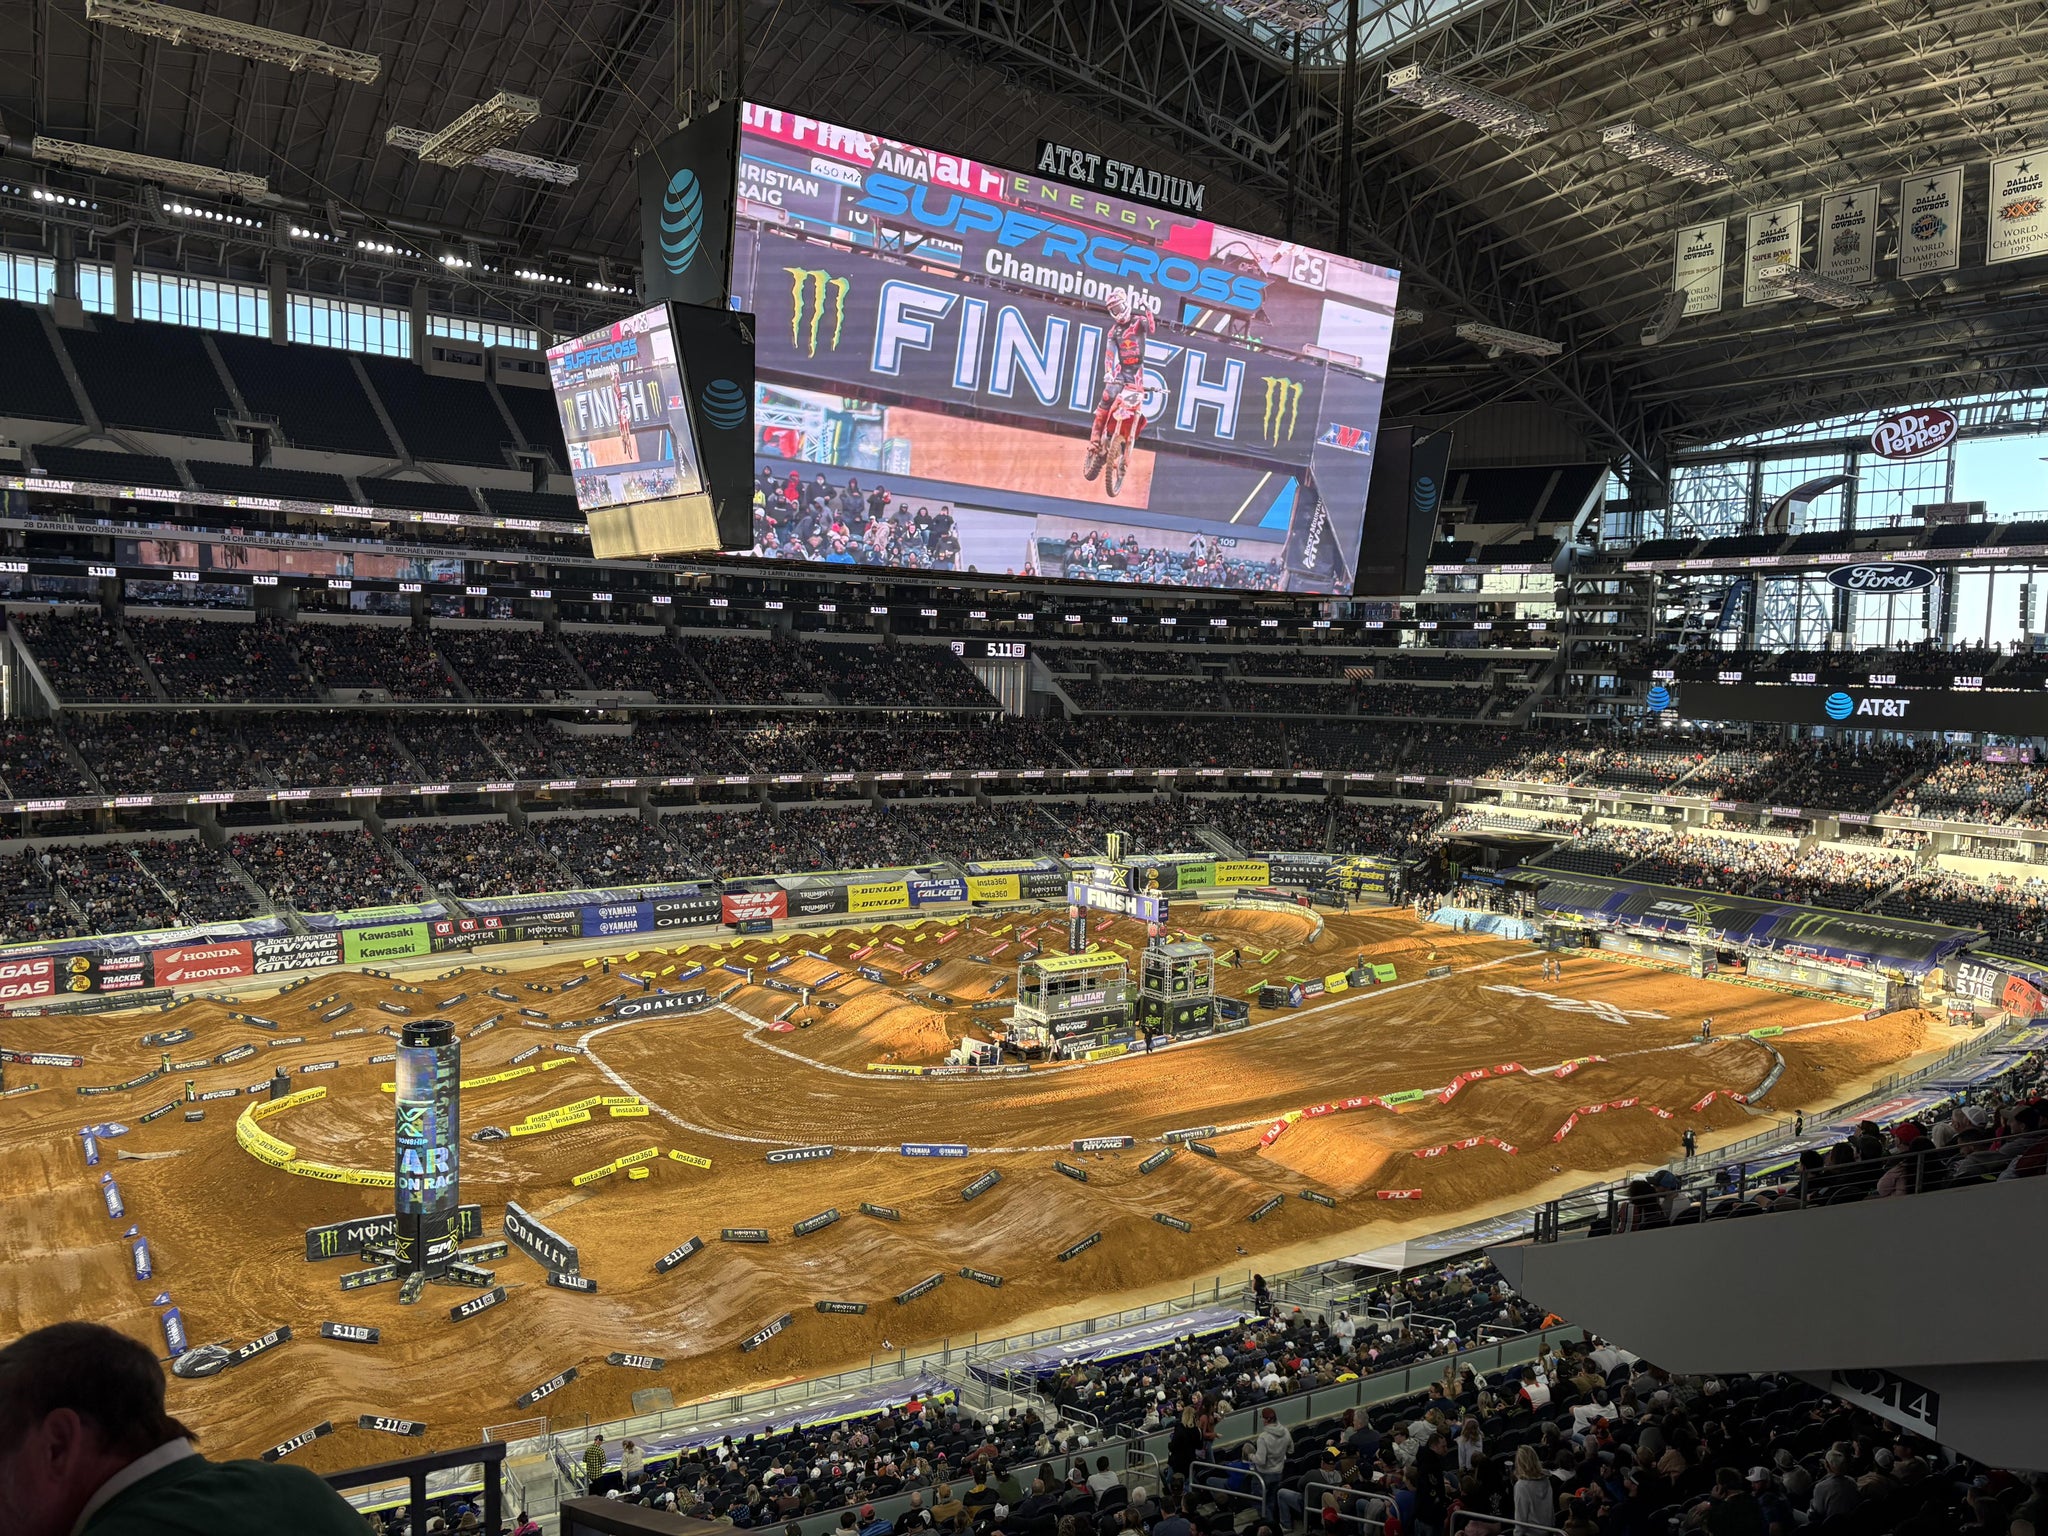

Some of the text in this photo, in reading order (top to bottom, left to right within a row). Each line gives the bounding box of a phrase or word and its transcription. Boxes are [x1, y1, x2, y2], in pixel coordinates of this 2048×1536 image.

[877, 150, 928, 183] AMA
[814, 165, 841, 181] 450
[1038, 142, 1100, 183] AT&T
[1105, 159, 1205, 212] STADIUM
[2007, 174, 2040, 187] DALLAS
[2002, 181, 2043, 197] COWBOYS
[1014, 176, 1161, 231] ENERGY
[1916, 193, 1946, 205] DALLAS
[1912, 200, 1949, 213] COWBOYS
[1835, 210, 1863, 221] DALLAS
[1831, 217, 1866, 229] COWBOYS
[1760, 227, 1787, 238] DALLAS
[2003, 225, 2038, 238] WORLD
[856, 172, 1269, 311] SUPERCROSS
[1757, 233, 1789, 246] COWBOYS
[1993, 232, 2048, 249] CHAMPIONS
[1687, 243, 1712, 253] DALLAS
[1912, 242, 1945, 254] WORLD
[2010, 244, 2031, 255] 1995
[1683, 250, 1715, 260] COWBOYS
[1752, 252, 1772, 262] SUPER
[1902, 249, 1954, 264] CHAMPIONS
[1831, 257, 1861, 268] WORLD
[1919, 260, 1938, 270] 1993
[1294, 255, 1323, 286] 25
[564, 338, 638, 370] SUPERCROSS
[1898, 415, 1930, 436] Dr
[1880, 420, 1951, 455] Pepper
[25, 479, 74, 489] MILITARY
[135, 488, 181, 498] MILITARY
[238, 497, 281, 507] MILITARY
[334, 505, 374, 515] MILITARY
[423, 512, 460, 521] MILITARY
[506, 518, 541, 527] MILITARY
[37, 522, 74, 532] DARREN
[77, 524, 123, 535] WOODSON
[221, 534, 295, 546] 94 CHARLES HALEY
[1219, 538, 1236, 547] 109
[395, 546, 424, 555] MICHAEL
[547, 556, 570, 564] AIKMAN
[654, 563, 677, 571] EMMITT
[1847, 566, 1914, 591] Ford
[987, 643, 1012, 657] 5.11
[1857, 699, 1909, 717] AT&T
[977, 878, 1008, 887] Insta360
[1095, 867, 1128, 887] SMX
[913, 879, 959, 888] FALKEN
[860, 885, 903, 895] DUNLOP
[917, 888, 962, 898] FALKEN
[979, 889, 1008, 899] Insta360
[673, 900, 719, 910] OAKLEY
[860, 898, 905, 909] DUNLOP
[1088, 889, 1137, 915] FINISH
[542, 911, 575, 919] amazon
[608, 906, 637, 915] YAMAHA
[608, 920, 638, 930] YAMAHA
[674, 914, 720, 924] OAKLEY
[359, 928, 414, 942] Kawasaki
[527, 925, 569, 935] MONSTER
[1835, 920, 1936, 940] MONSTER
[267, 932, 337, 946] ROCKY MOUNTAIN
[448, 931, 495, 945] MONSTER
[183, 948, 241, 961] HONDA
[268, 950, 338, 963] ROCKY MOUNTAIN
[360, 944, 416, 958] Kawasaki
[103, 956, 140, 965] TRACKER
[1057, 954, 1117, 968] DUNLOP
[0, 962, 49, 978] GAS
[184, 966, 242, 979] HONDA
[1957, 962, 1986, 982] 5.11
[103, 974, 141, 984] TRACKER
[1, 981, 50, 998] GAS
[643, 994, 704, 1011] OAKLEY
[1071, 991, 1106, 1003] MILITARY
[504, 1067, 531, 1079] Insta360
[1470, 1070, 1484, 1079] FLY
[1501, 1064, 1516, 1073] FLY
[469, 1076, 496, 1087] Insta360
[1444, 1080, 1460, 1099] FLY
[298, 1090, 325, 1103] DUNLOP
[607, 1097, 635, 1105] Insta360
[1347, 1098, 1362, 1107] FLY
[1390, 1093, 1415, 1103] Kawasaki
[263, 1100, 290, 1116] DUNLOP
[568, 1098, 597, 1112] Insta360
[1310, 1104, 1326, 1115] FLY
[531, 1110, 560, 1122] Insta360
[555, 1111, 585, 1123] Insta360
[516, 1122, 546, 1132] Insta360
[1267, 1122, 1281, 1140] FLY
[258, 1139, 289, 1158] DUNLOP
[787, 1149, 832, 1160] OAKLEY
[1425, 1147, 1441, 1158] FLY
[297, 1168, 342, 1181] DUNLOP
[579, 1167, 611, 1184] Insta360
[1387, 1191, 1412, 1199] FLY
[519, 1228, 568, 1269] OAKLEY
[664, 1247, 684, 1266] 5.11
[559, 1273, 577, 1287] 5.11
[461, 1298, 484, 1315] 5.11
[753, 1328, 773, 1346] 5.11
[622, 1354, 643, 1367] 5.11
[531, 1381, 554, 1401] 5.11
